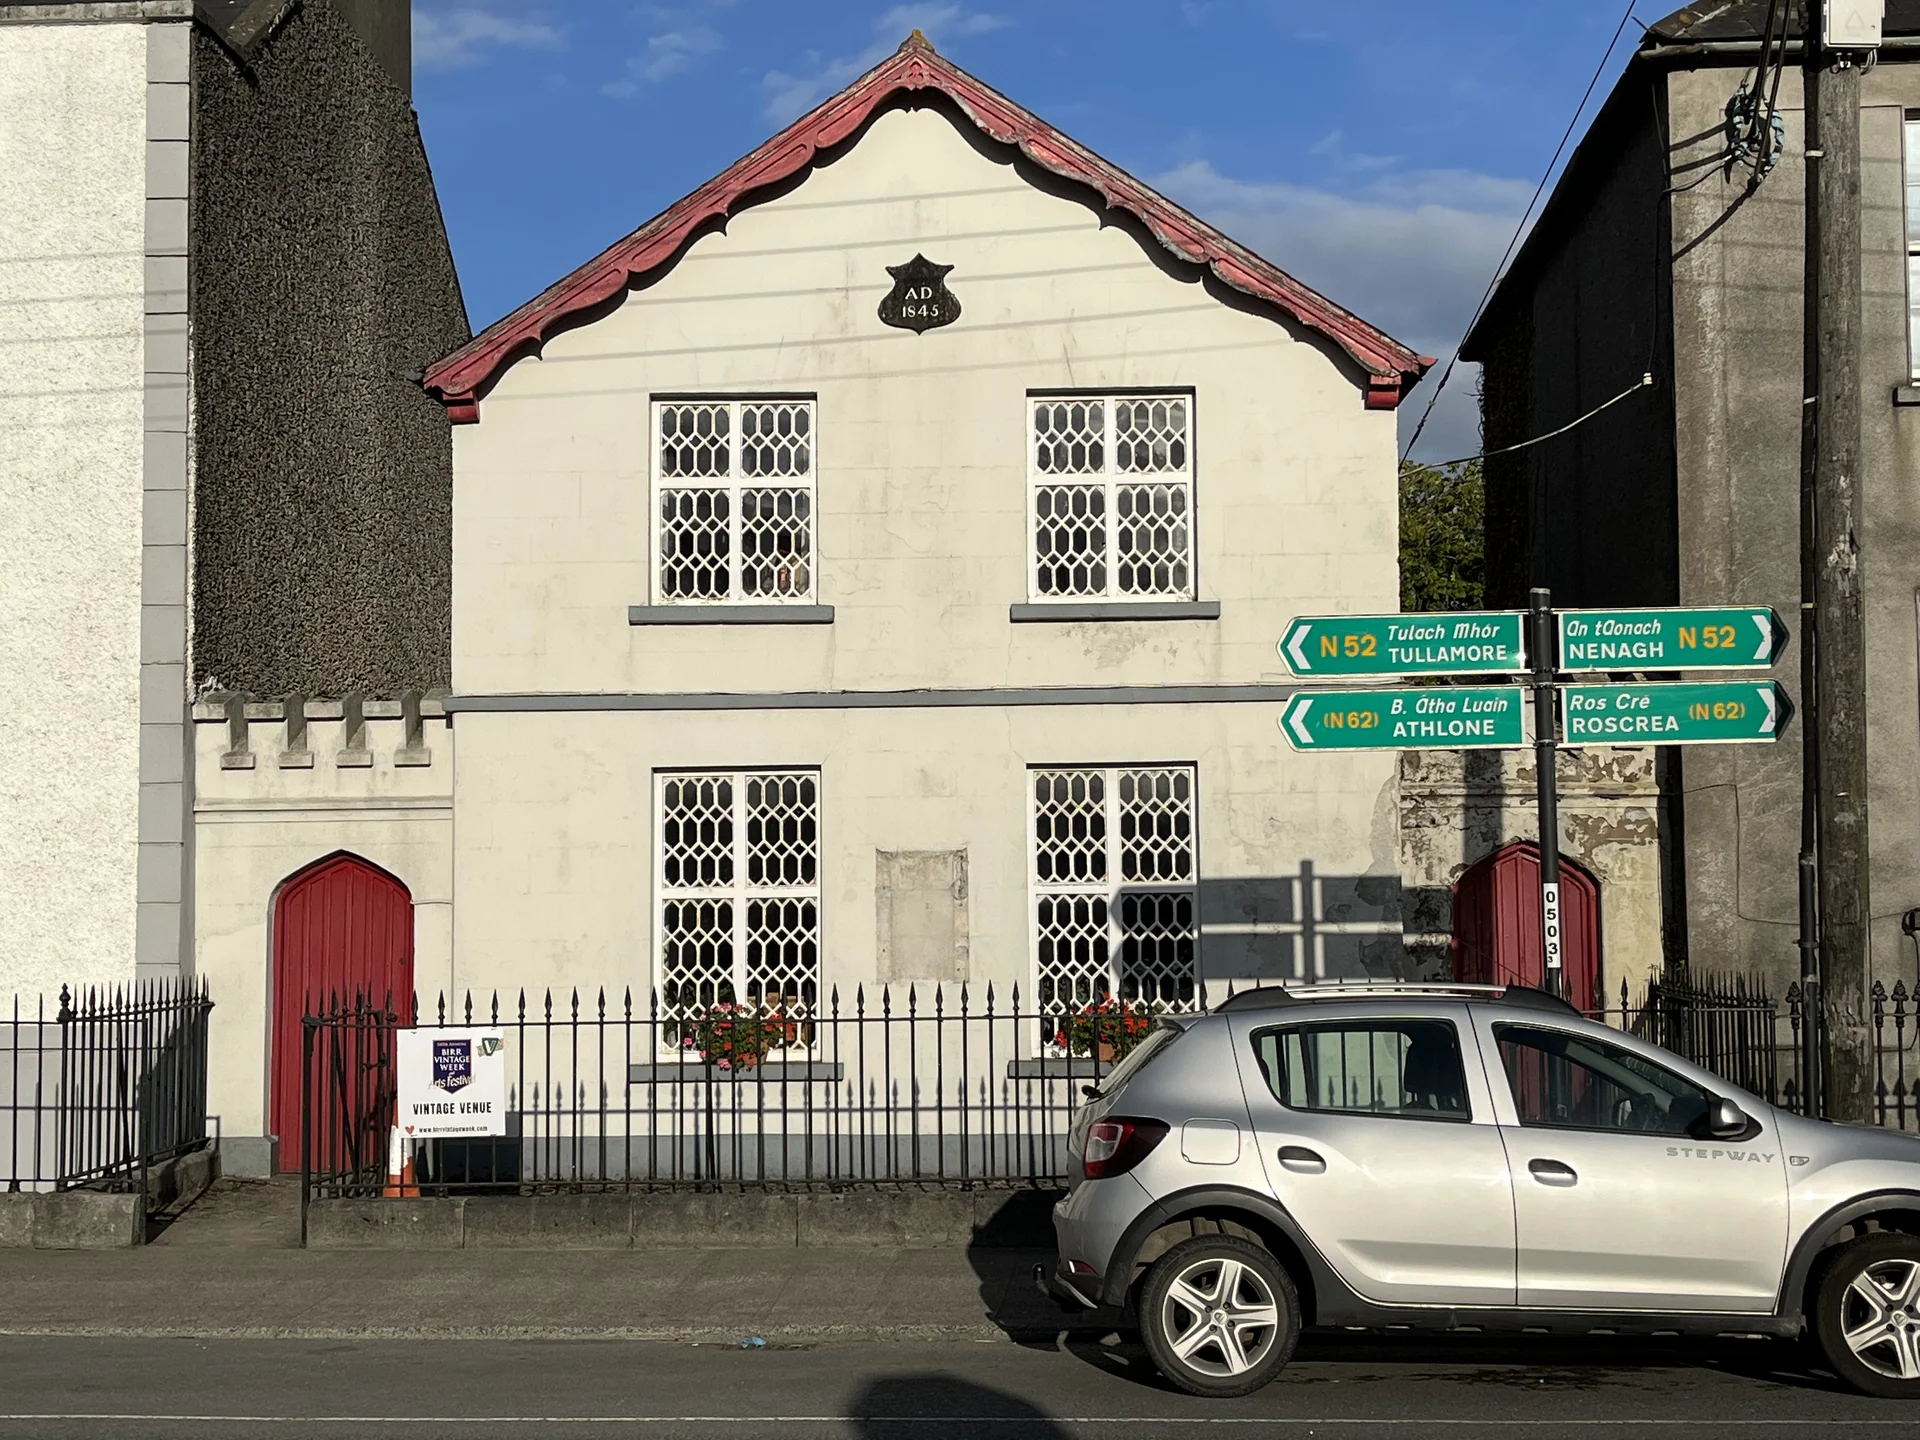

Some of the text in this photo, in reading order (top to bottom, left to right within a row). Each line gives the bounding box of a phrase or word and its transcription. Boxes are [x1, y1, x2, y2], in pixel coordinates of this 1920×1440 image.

[905, 286, 933, 300] AD
[902, 304, 939, 318] 1845
[1387, 622, 1501, 641] Tulach Mhór
[1566, 618, 1662, 637] An tAonach
[1678, 625, 1736, 649] N 52
[1320, 634, 1377, 658] N 52
[1387, 644, 1508, 664] TULLAMORE
[1569, 641, 1664, 660] NENAGH
[1390, 698, 1408, 715] B.
[1461, 696, 1509, 714] Luain
[1569, 693, 1651, 711] Ros Cré
[1688, 702, 1746, 721] (N 62)
[1323, 711, 1379, 729] (N 62)
[1392, 719, 1496, 738] ATHLONE
[1572, 715, 1680, 734] ROSCREA
[439, 1063, 466, 1071] WEEK
[413, 1101, 492, 1115] VINTAGE VENUE
[1665, 1146, 1776, 1163] STEPWAY
